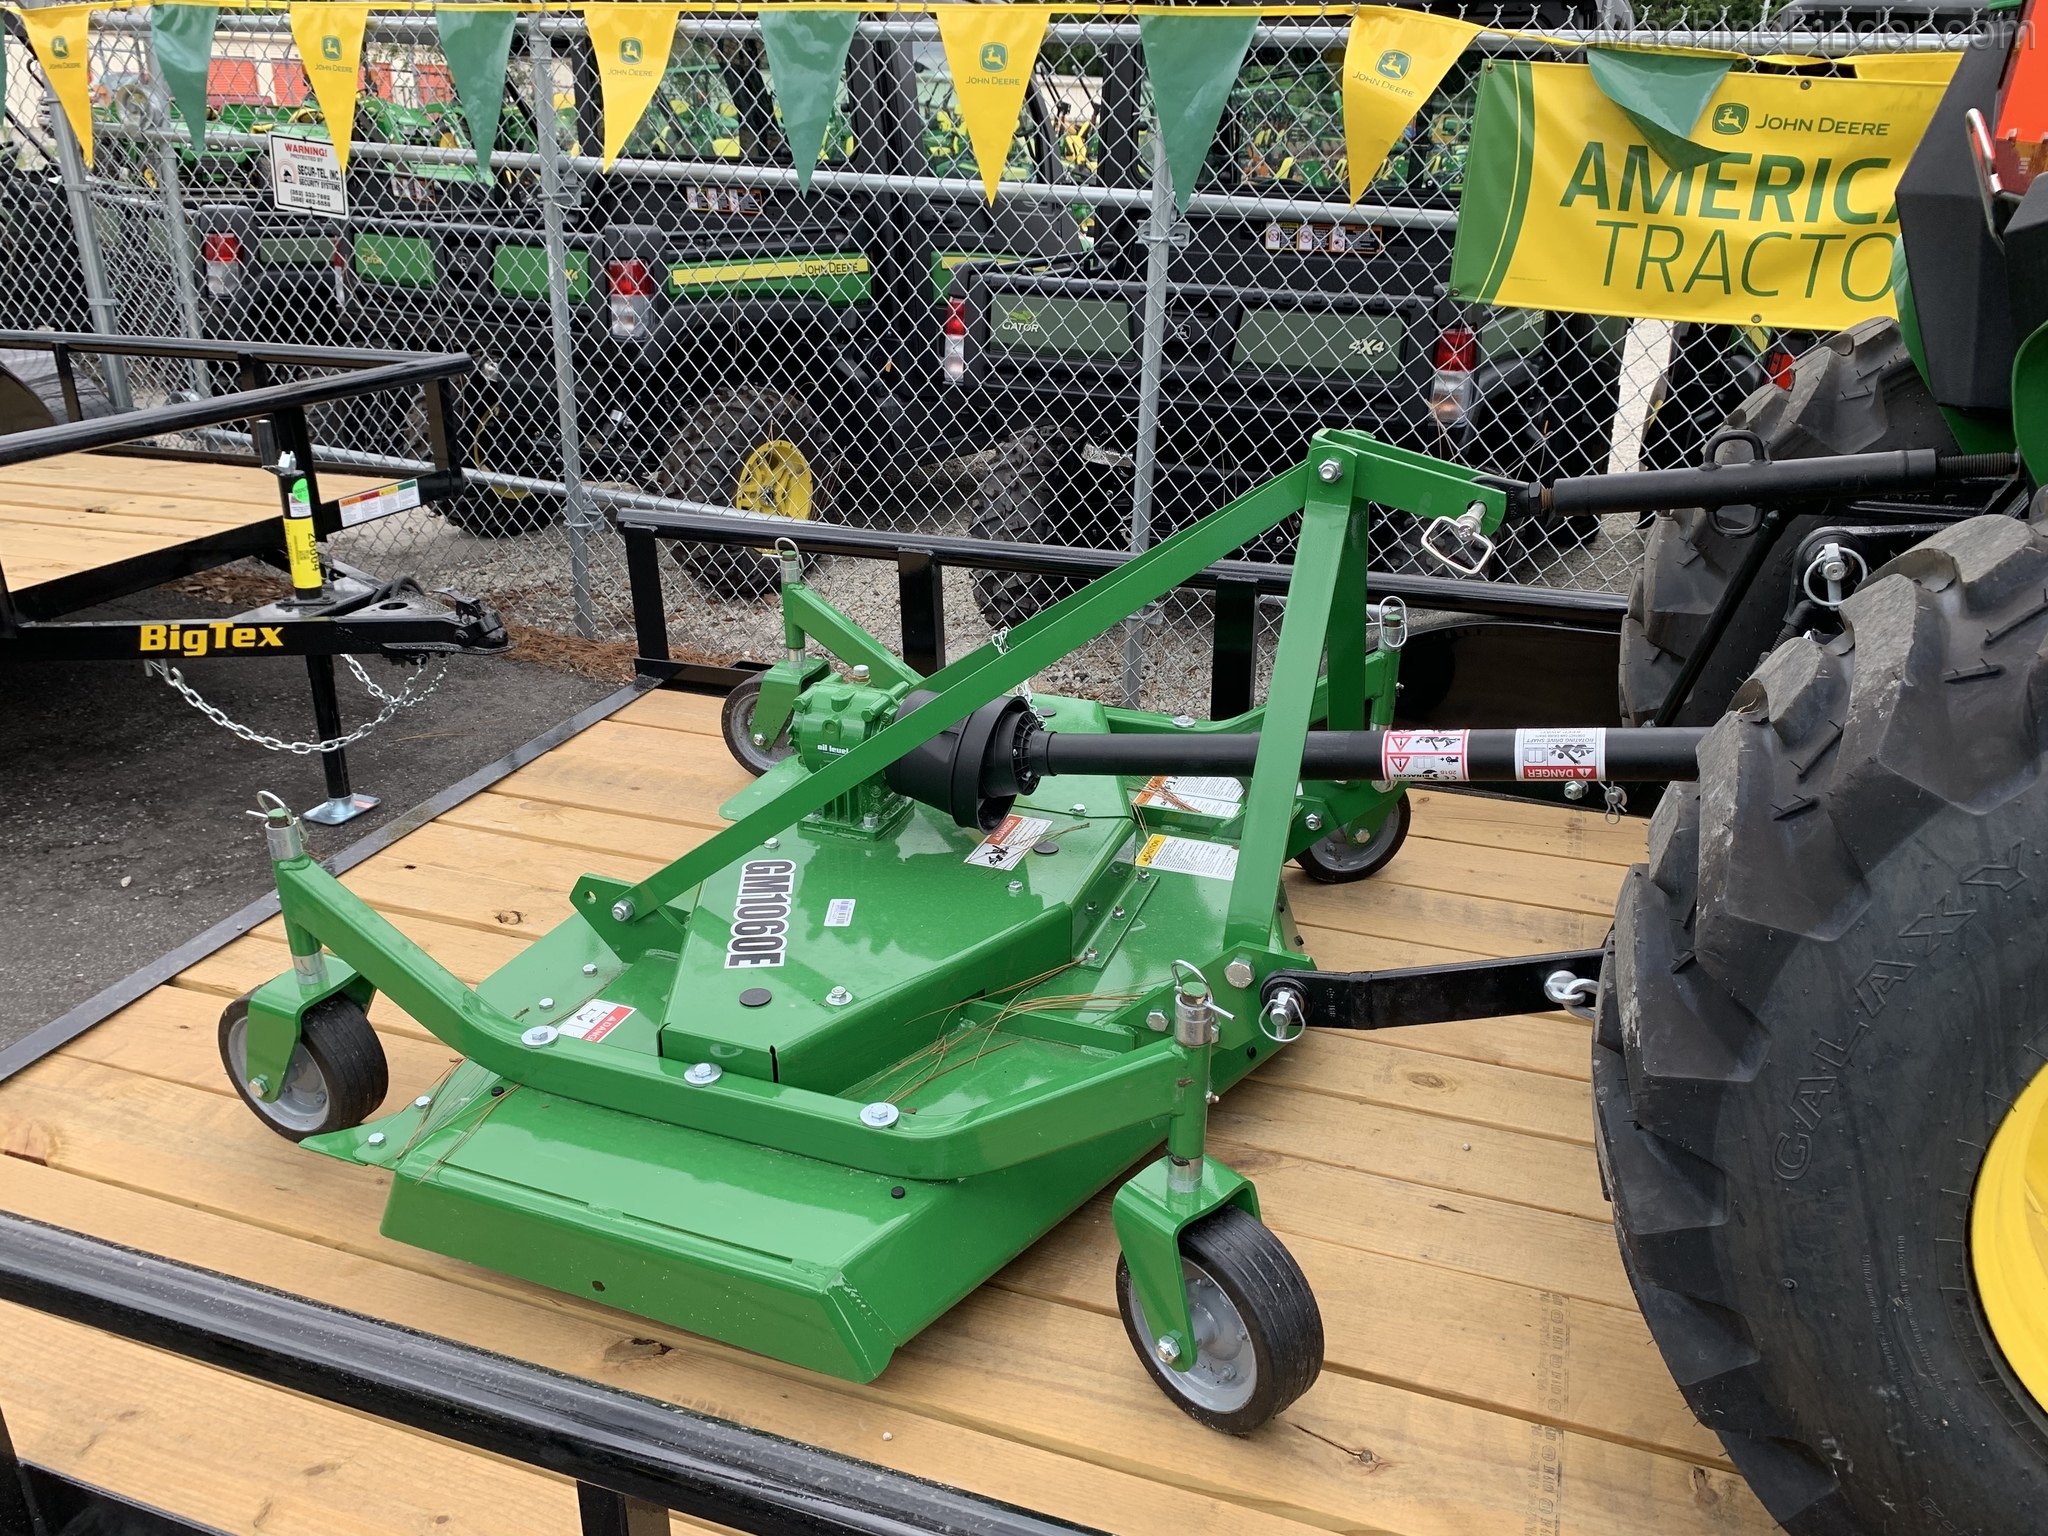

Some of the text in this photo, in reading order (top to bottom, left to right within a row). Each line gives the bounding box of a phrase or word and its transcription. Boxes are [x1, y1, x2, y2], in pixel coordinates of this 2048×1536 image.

[315, 63, 353, 73] JOHN DEERE
[607, 68, 653, 77] JOHN DEERE
[966, 76, 1020, 86] JOHN DEERE
[1352, 71, 1415, 97] JOHN DEERE
[1755, 113, 1890, 136] JOHN DEERE
[284, 143, 327, 157] WARNING!
[299, 179, 341, 192] SECURITY SYSTEMS
[1559, 141, 1899, 225] AMERIC
[1002, 320, 1039, 333] GATOR
[140, 622, 284, 657] BigTex
[829, 745, 849, 755] level
[1527, 769, 1574, 778] DANGER
[727, 860, 795, 968] GM1060E
[1771, 838, 2028, 1181] GALAXY
